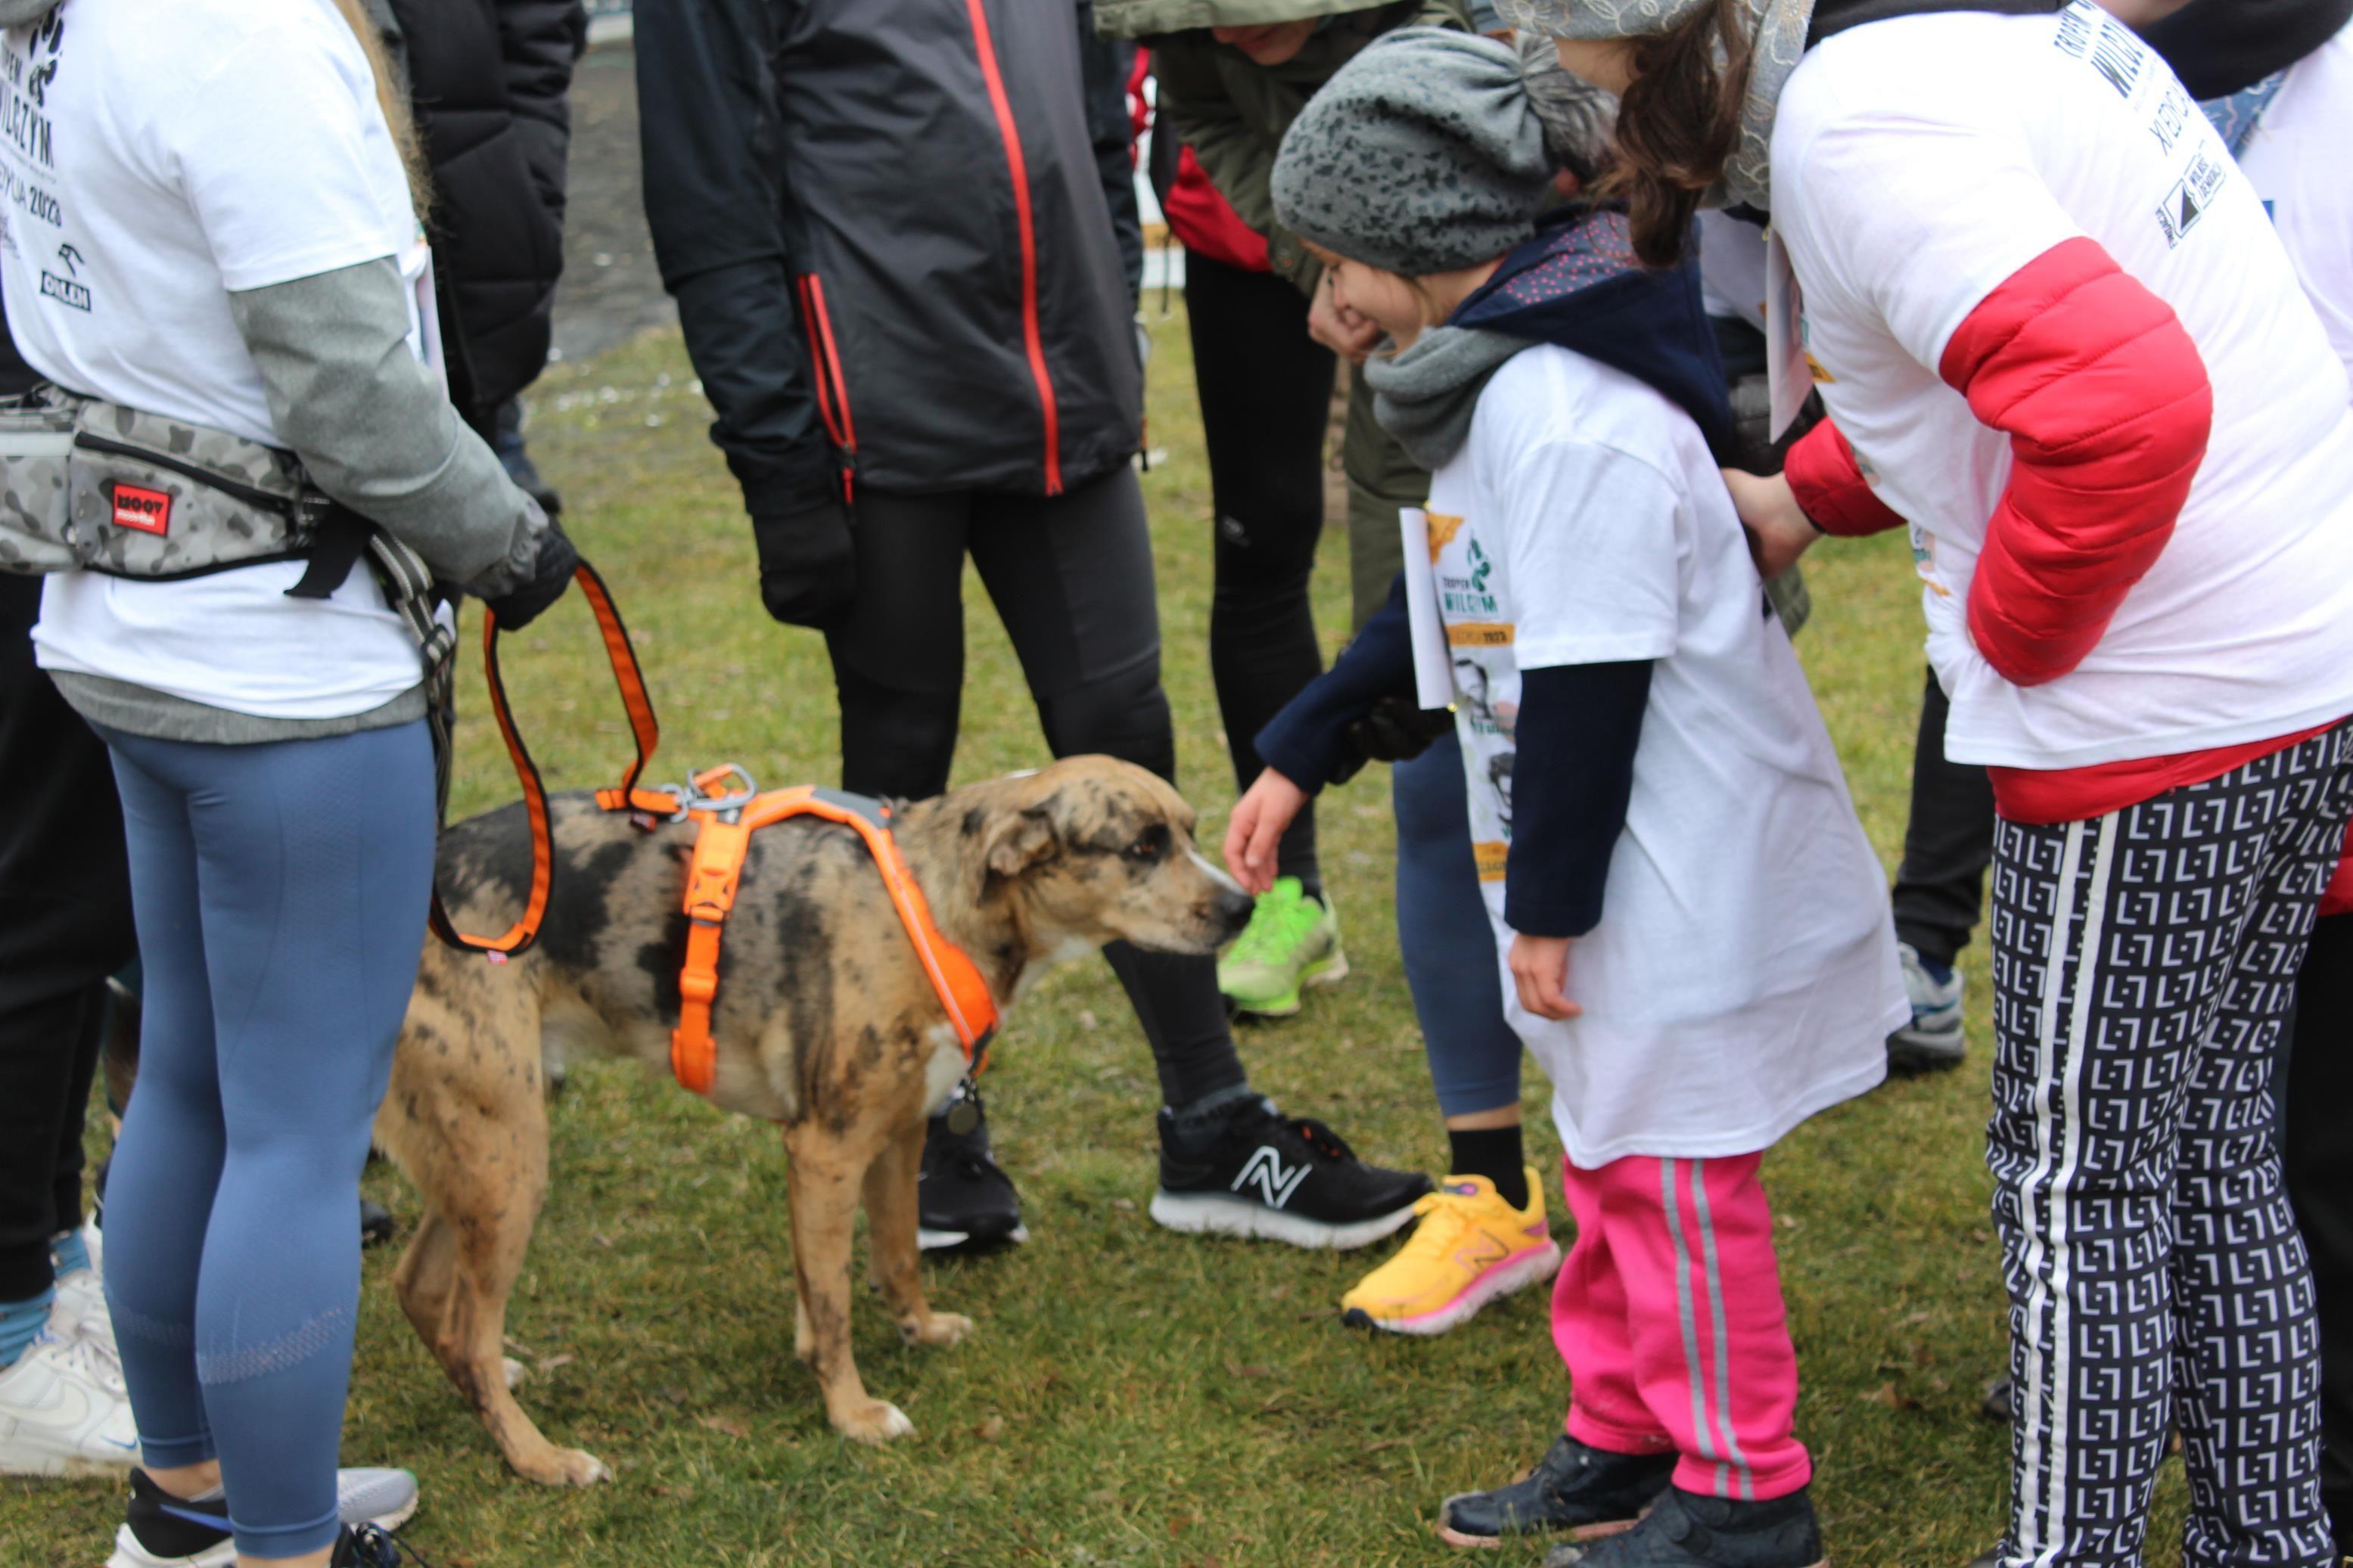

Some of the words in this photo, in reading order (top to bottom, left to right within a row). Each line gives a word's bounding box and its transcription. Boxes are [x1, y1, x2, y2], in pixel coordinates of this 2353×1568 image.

[2090, 17, 2146, 99] WILCZY
[0, 80, 54, 169] ILCZYM
[42, 272, 91, 312] ORLEN
